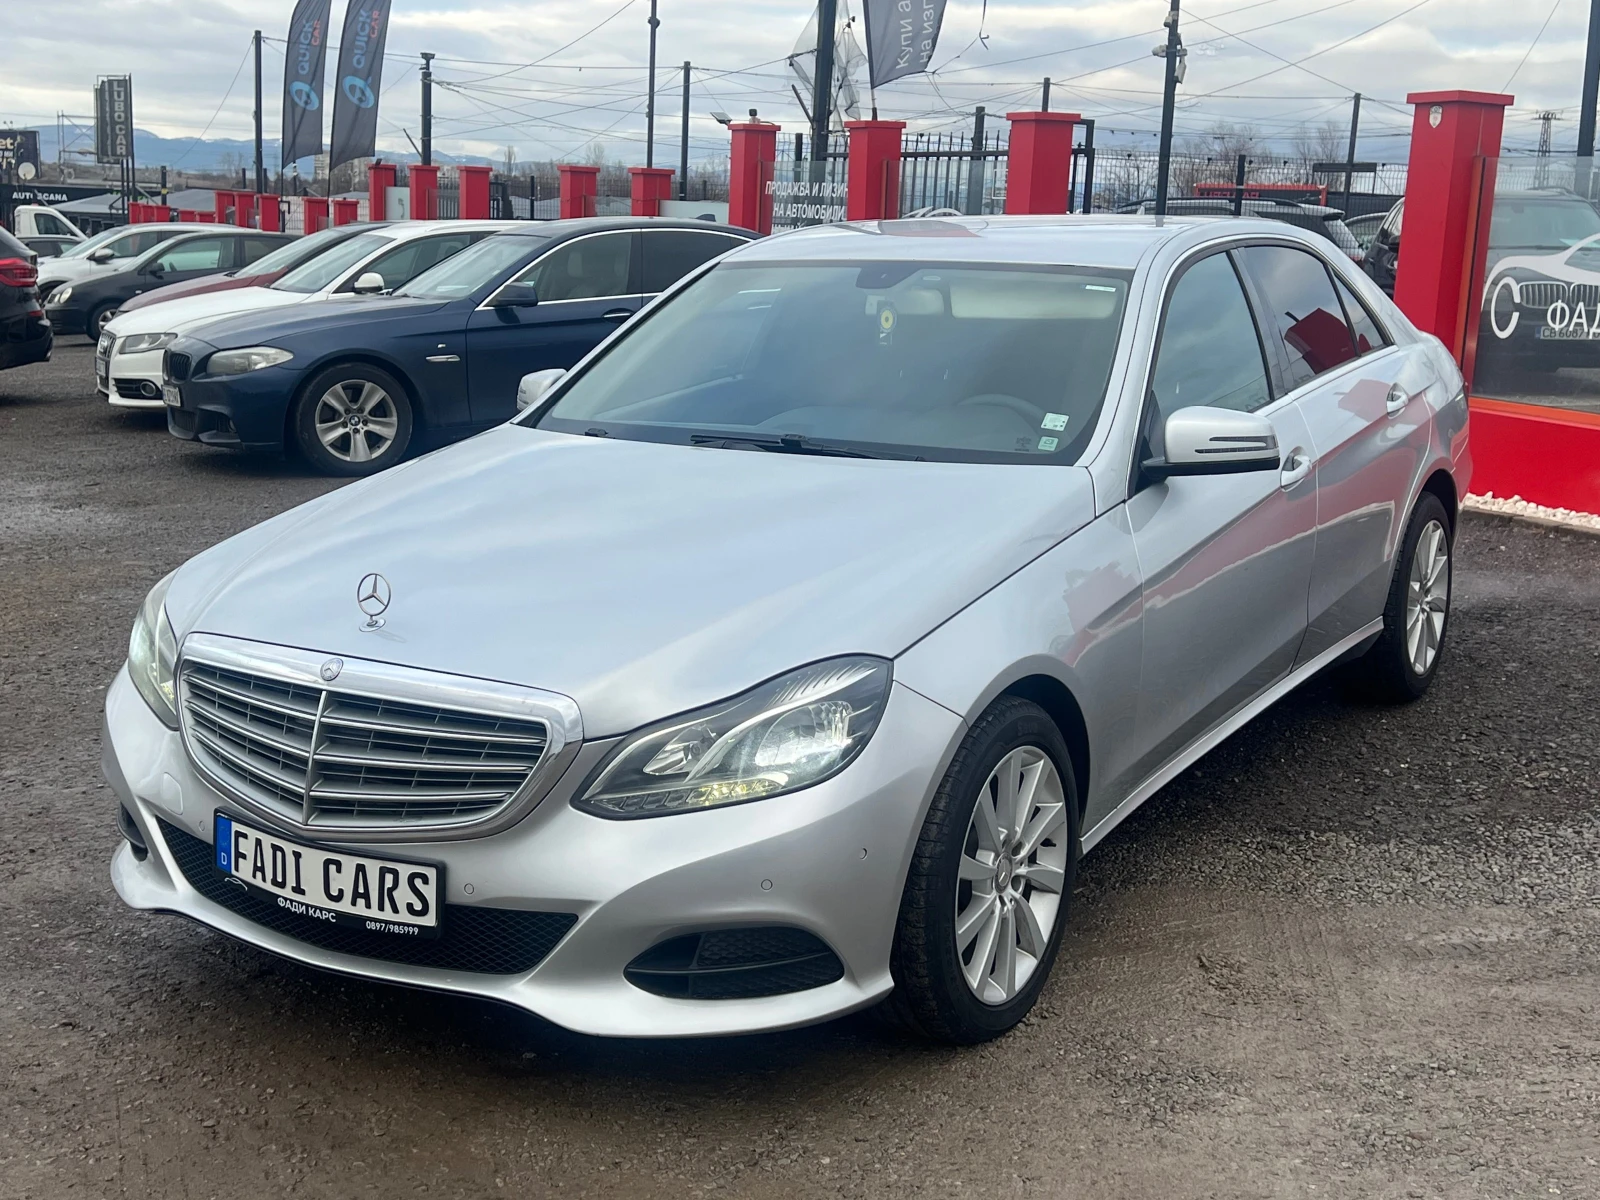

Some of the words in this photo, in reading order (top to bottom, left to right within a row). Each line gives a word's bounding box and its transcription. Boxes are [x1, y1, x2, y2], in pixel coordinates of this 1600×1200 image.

[311, 19, 320, 46] CAR
[369, 10, 380, 38] CAR
[298, 20, 313, 75] QUICK
[353, 9, 371, 69] QUICK
[896, 19, 913, 69] Купи
[920, 39, 932, 63] на
[113, 81, 125, 122] LUBO
[115, 124, 127, 155] CAR
[765, 181, 810, 198] ПРОДАЖБА
[812, 182, 819, 197] И
[773, 203, 784, 217] НА
[786, 203, 847, 221] АВТОМОБИЛИ
[221, 852, 227, 865] D
[234, 829, 306, 896] FADI
[323, 858, 430, 917] CARS
[277, 897, 308, 914] ФАДИ
[308, 907, 336, 923] КАРС
[365, 921, 419, 935] 0897/985999
